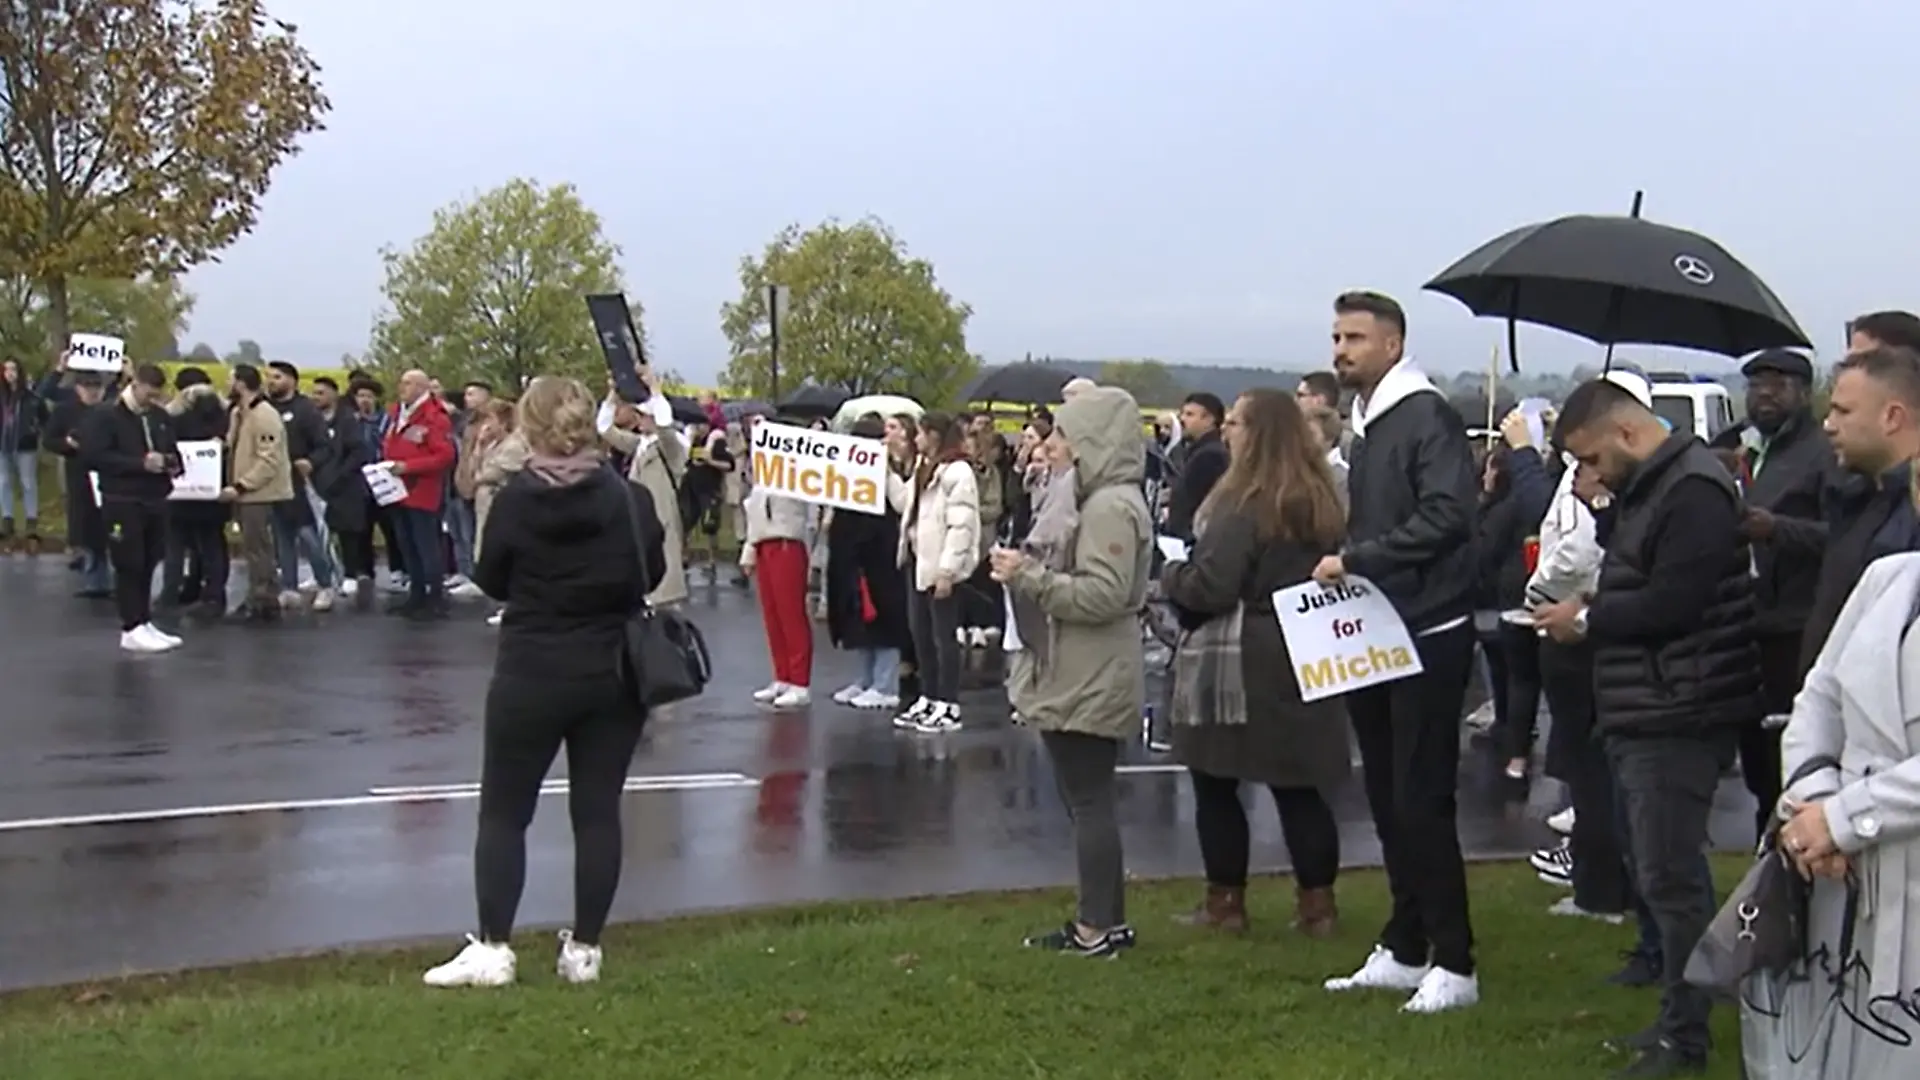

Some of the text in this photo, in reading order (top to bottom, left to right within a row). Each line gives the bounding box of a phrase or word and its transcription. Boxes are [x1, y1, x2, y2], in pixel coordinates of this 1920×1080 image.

[70, 342, 120, 363] Help
[755, 429, 879, 466] Justice for
[754, 451, 878, 505] Micha
[1331, 618, 1363, 640] for
[1301, 646, 1413, 689] Micha
